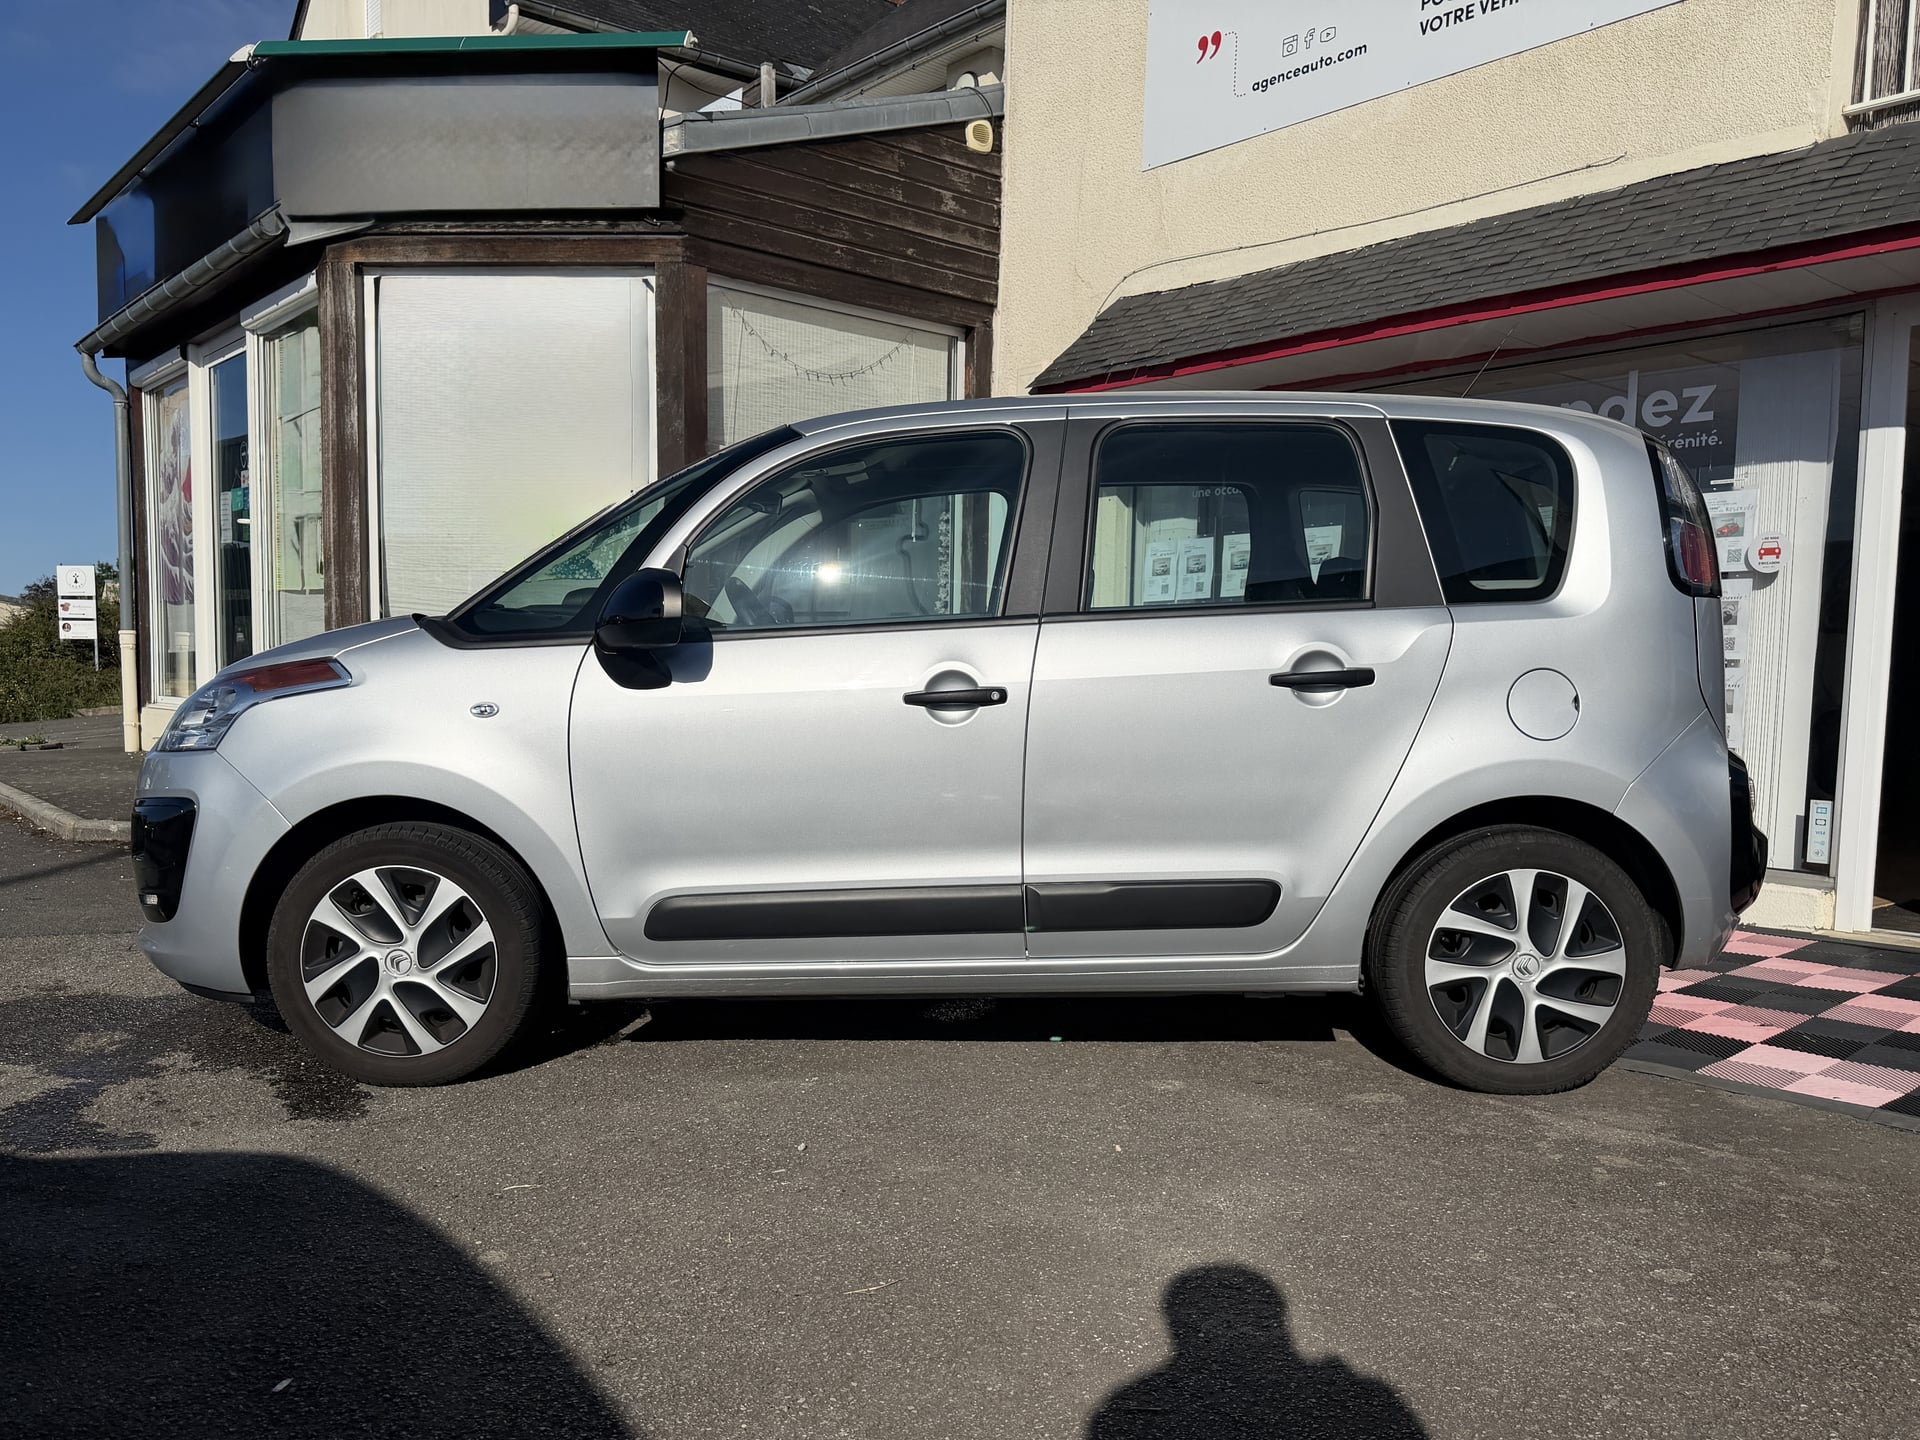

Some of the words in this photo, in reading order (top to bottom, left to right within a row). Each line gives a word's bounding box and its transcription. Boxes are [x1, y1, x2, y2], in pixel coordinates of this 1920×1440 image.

[1419, 3, 1475, 36] VOTRE
[1251, 43, 1368, 93] agenceauto.com
[1660, 429, 1723, 449] rénité.
[1191, 488, 1211, 498] une
